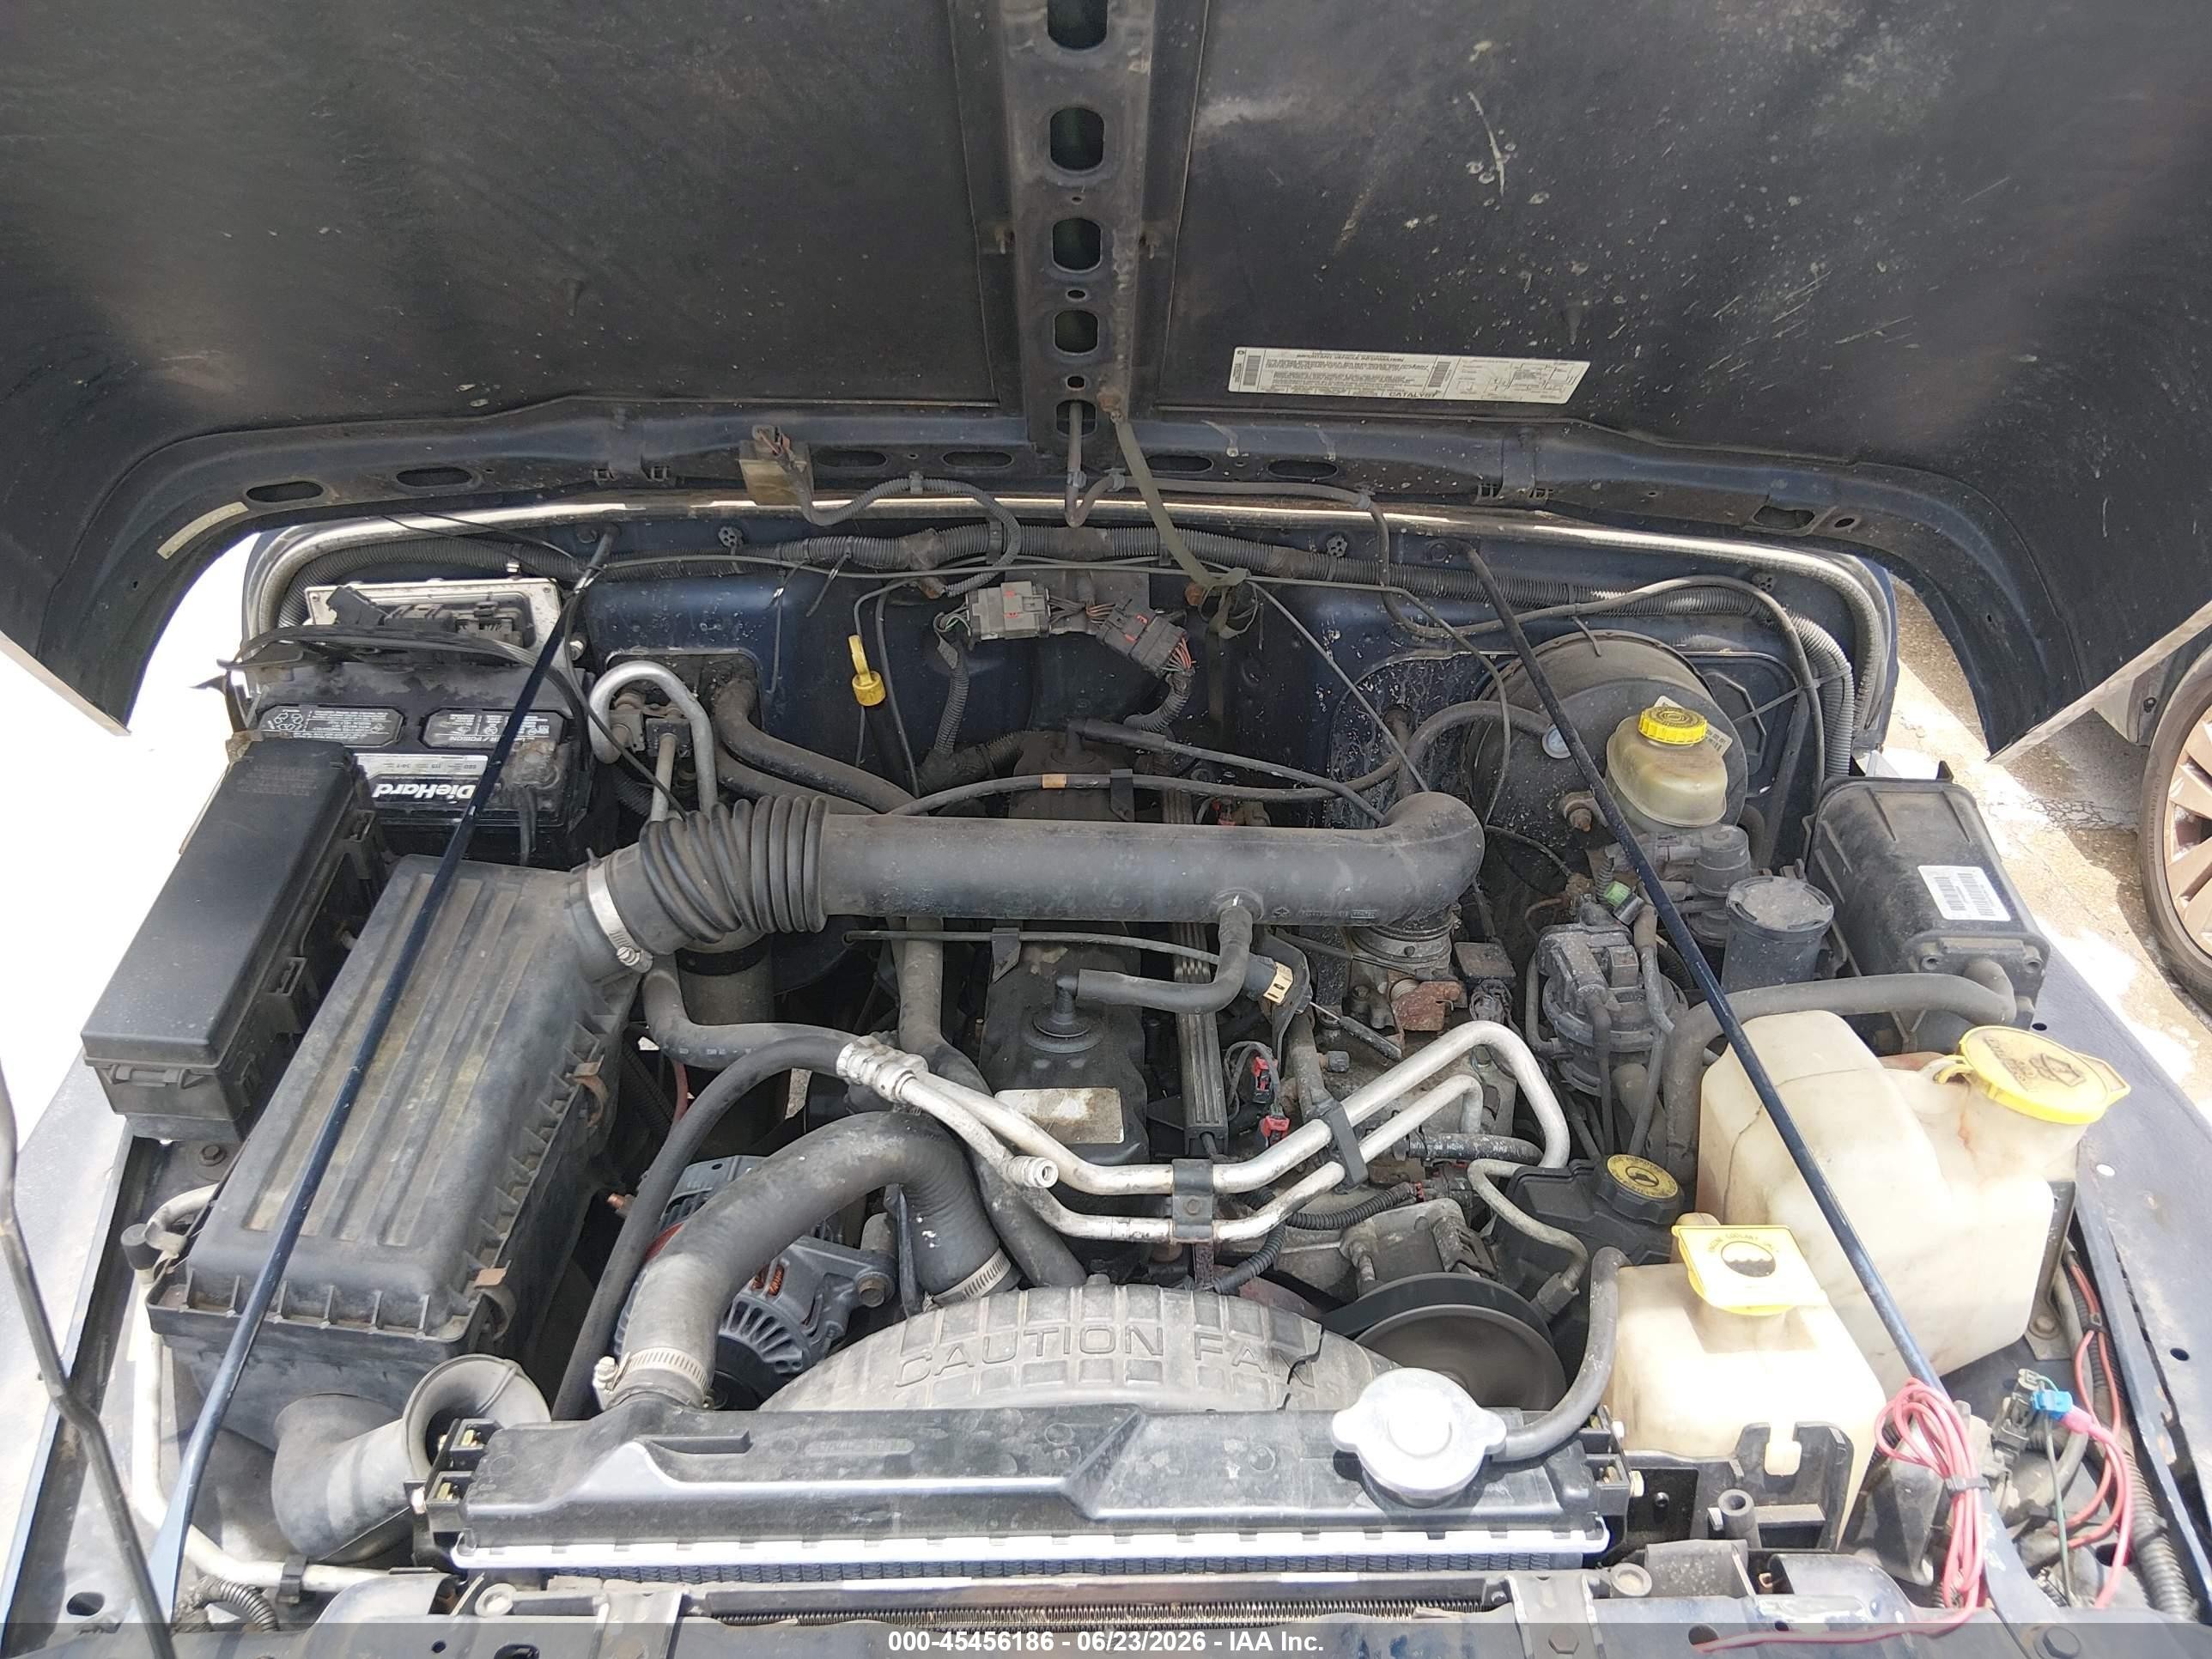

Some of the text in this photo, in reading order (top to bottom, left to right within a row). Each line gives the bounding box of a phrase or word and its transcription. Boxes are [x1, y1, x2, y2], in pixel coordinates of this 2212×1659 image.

[371, 782, 477, 801] DieHard
[895, 1326, 1316, 1389] CAUTION FAN
